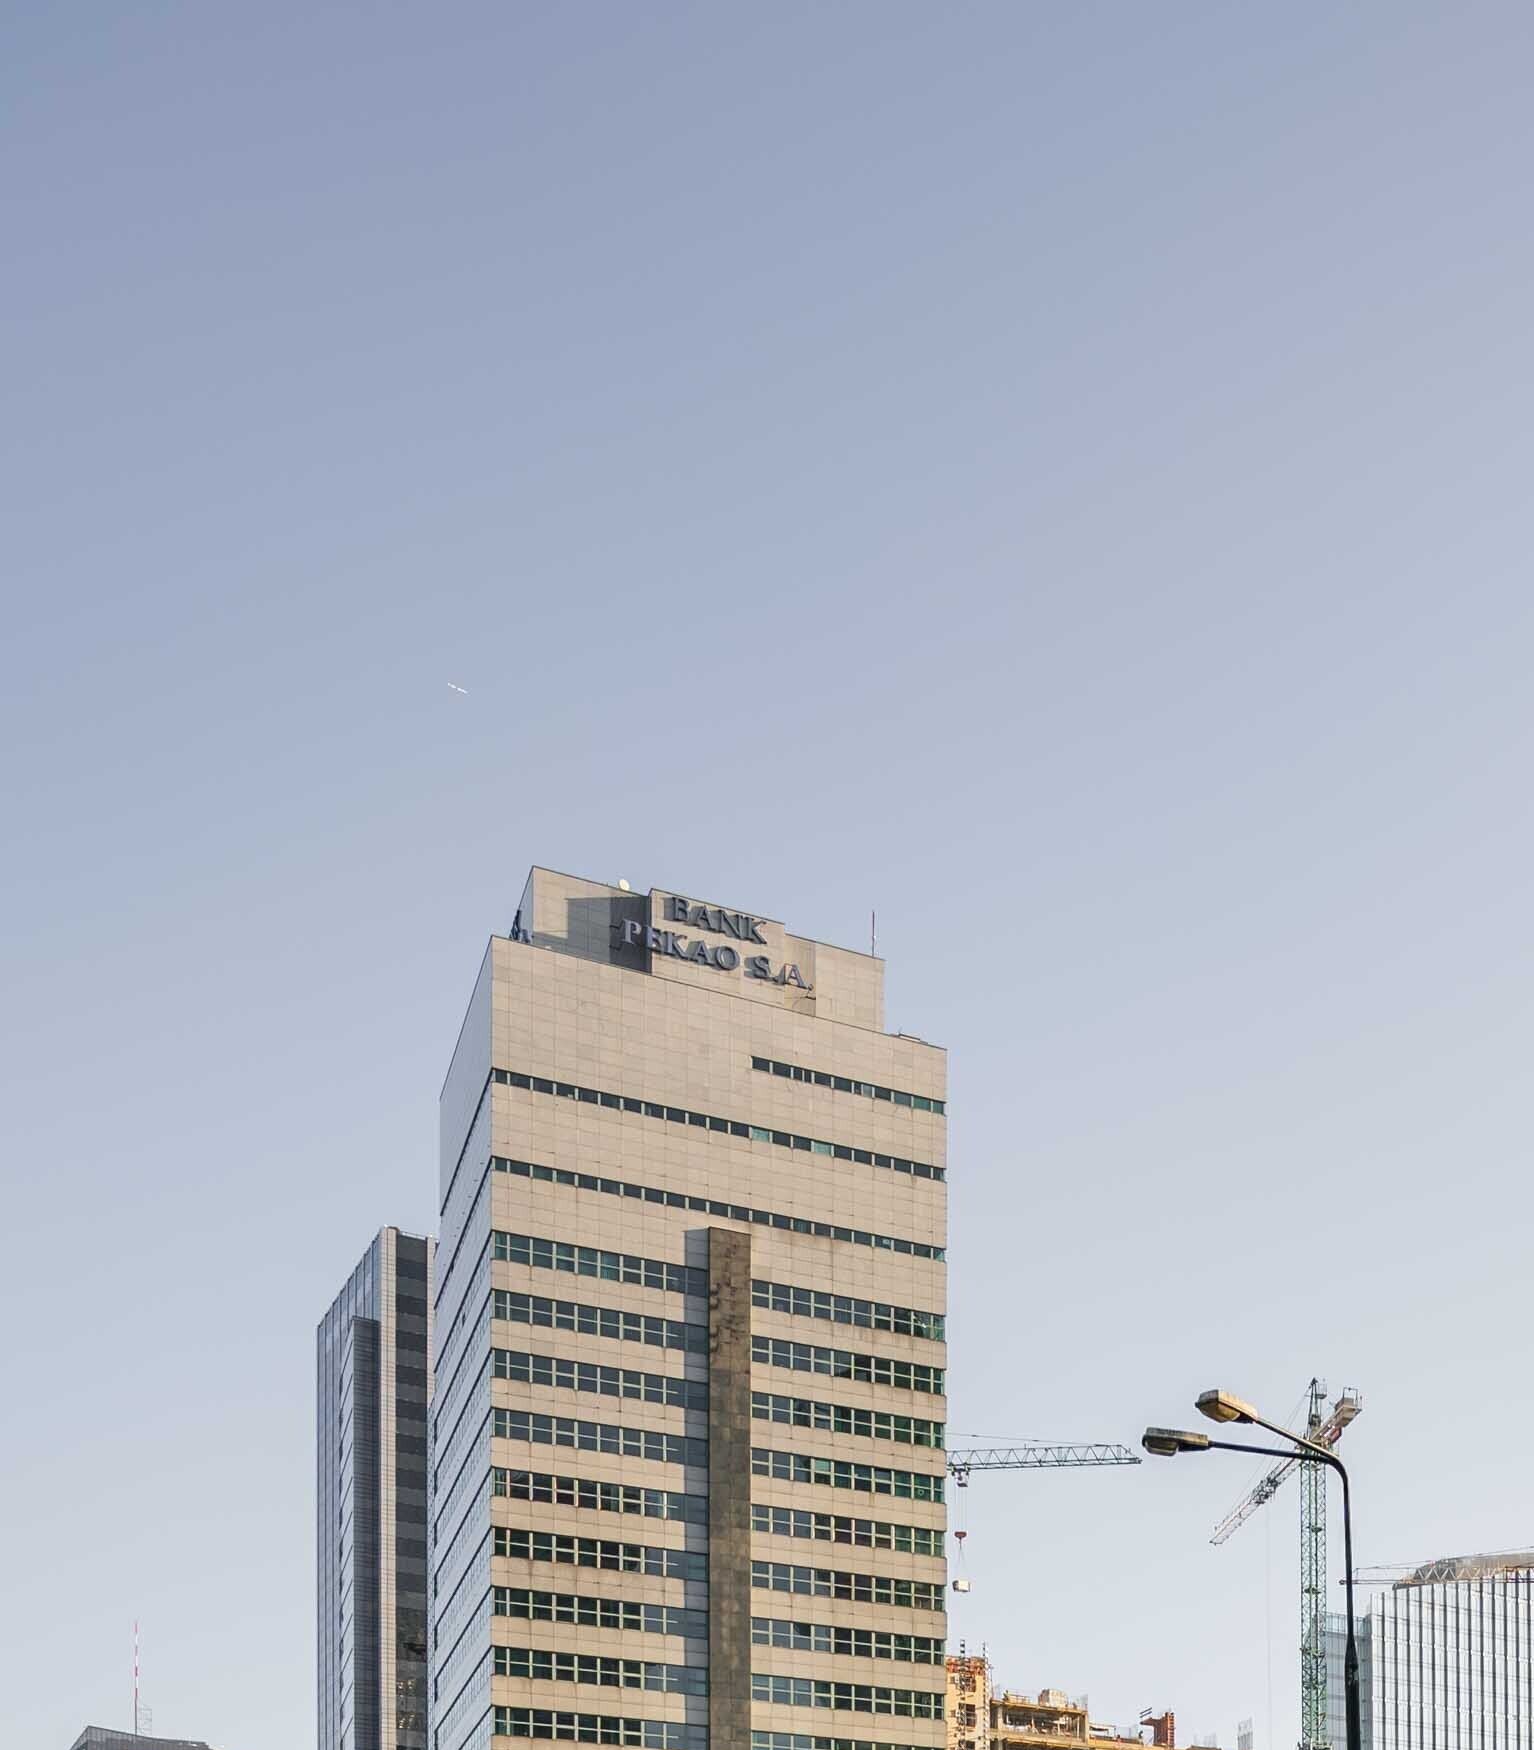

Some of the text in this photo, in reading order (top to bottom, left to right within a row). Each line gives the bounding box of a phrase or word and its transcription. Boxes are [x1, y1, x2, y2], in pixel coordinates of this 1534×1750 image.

[671, 896, 767, 944] BANK
[622, 918, 814, 991] PEKAO S.A.
